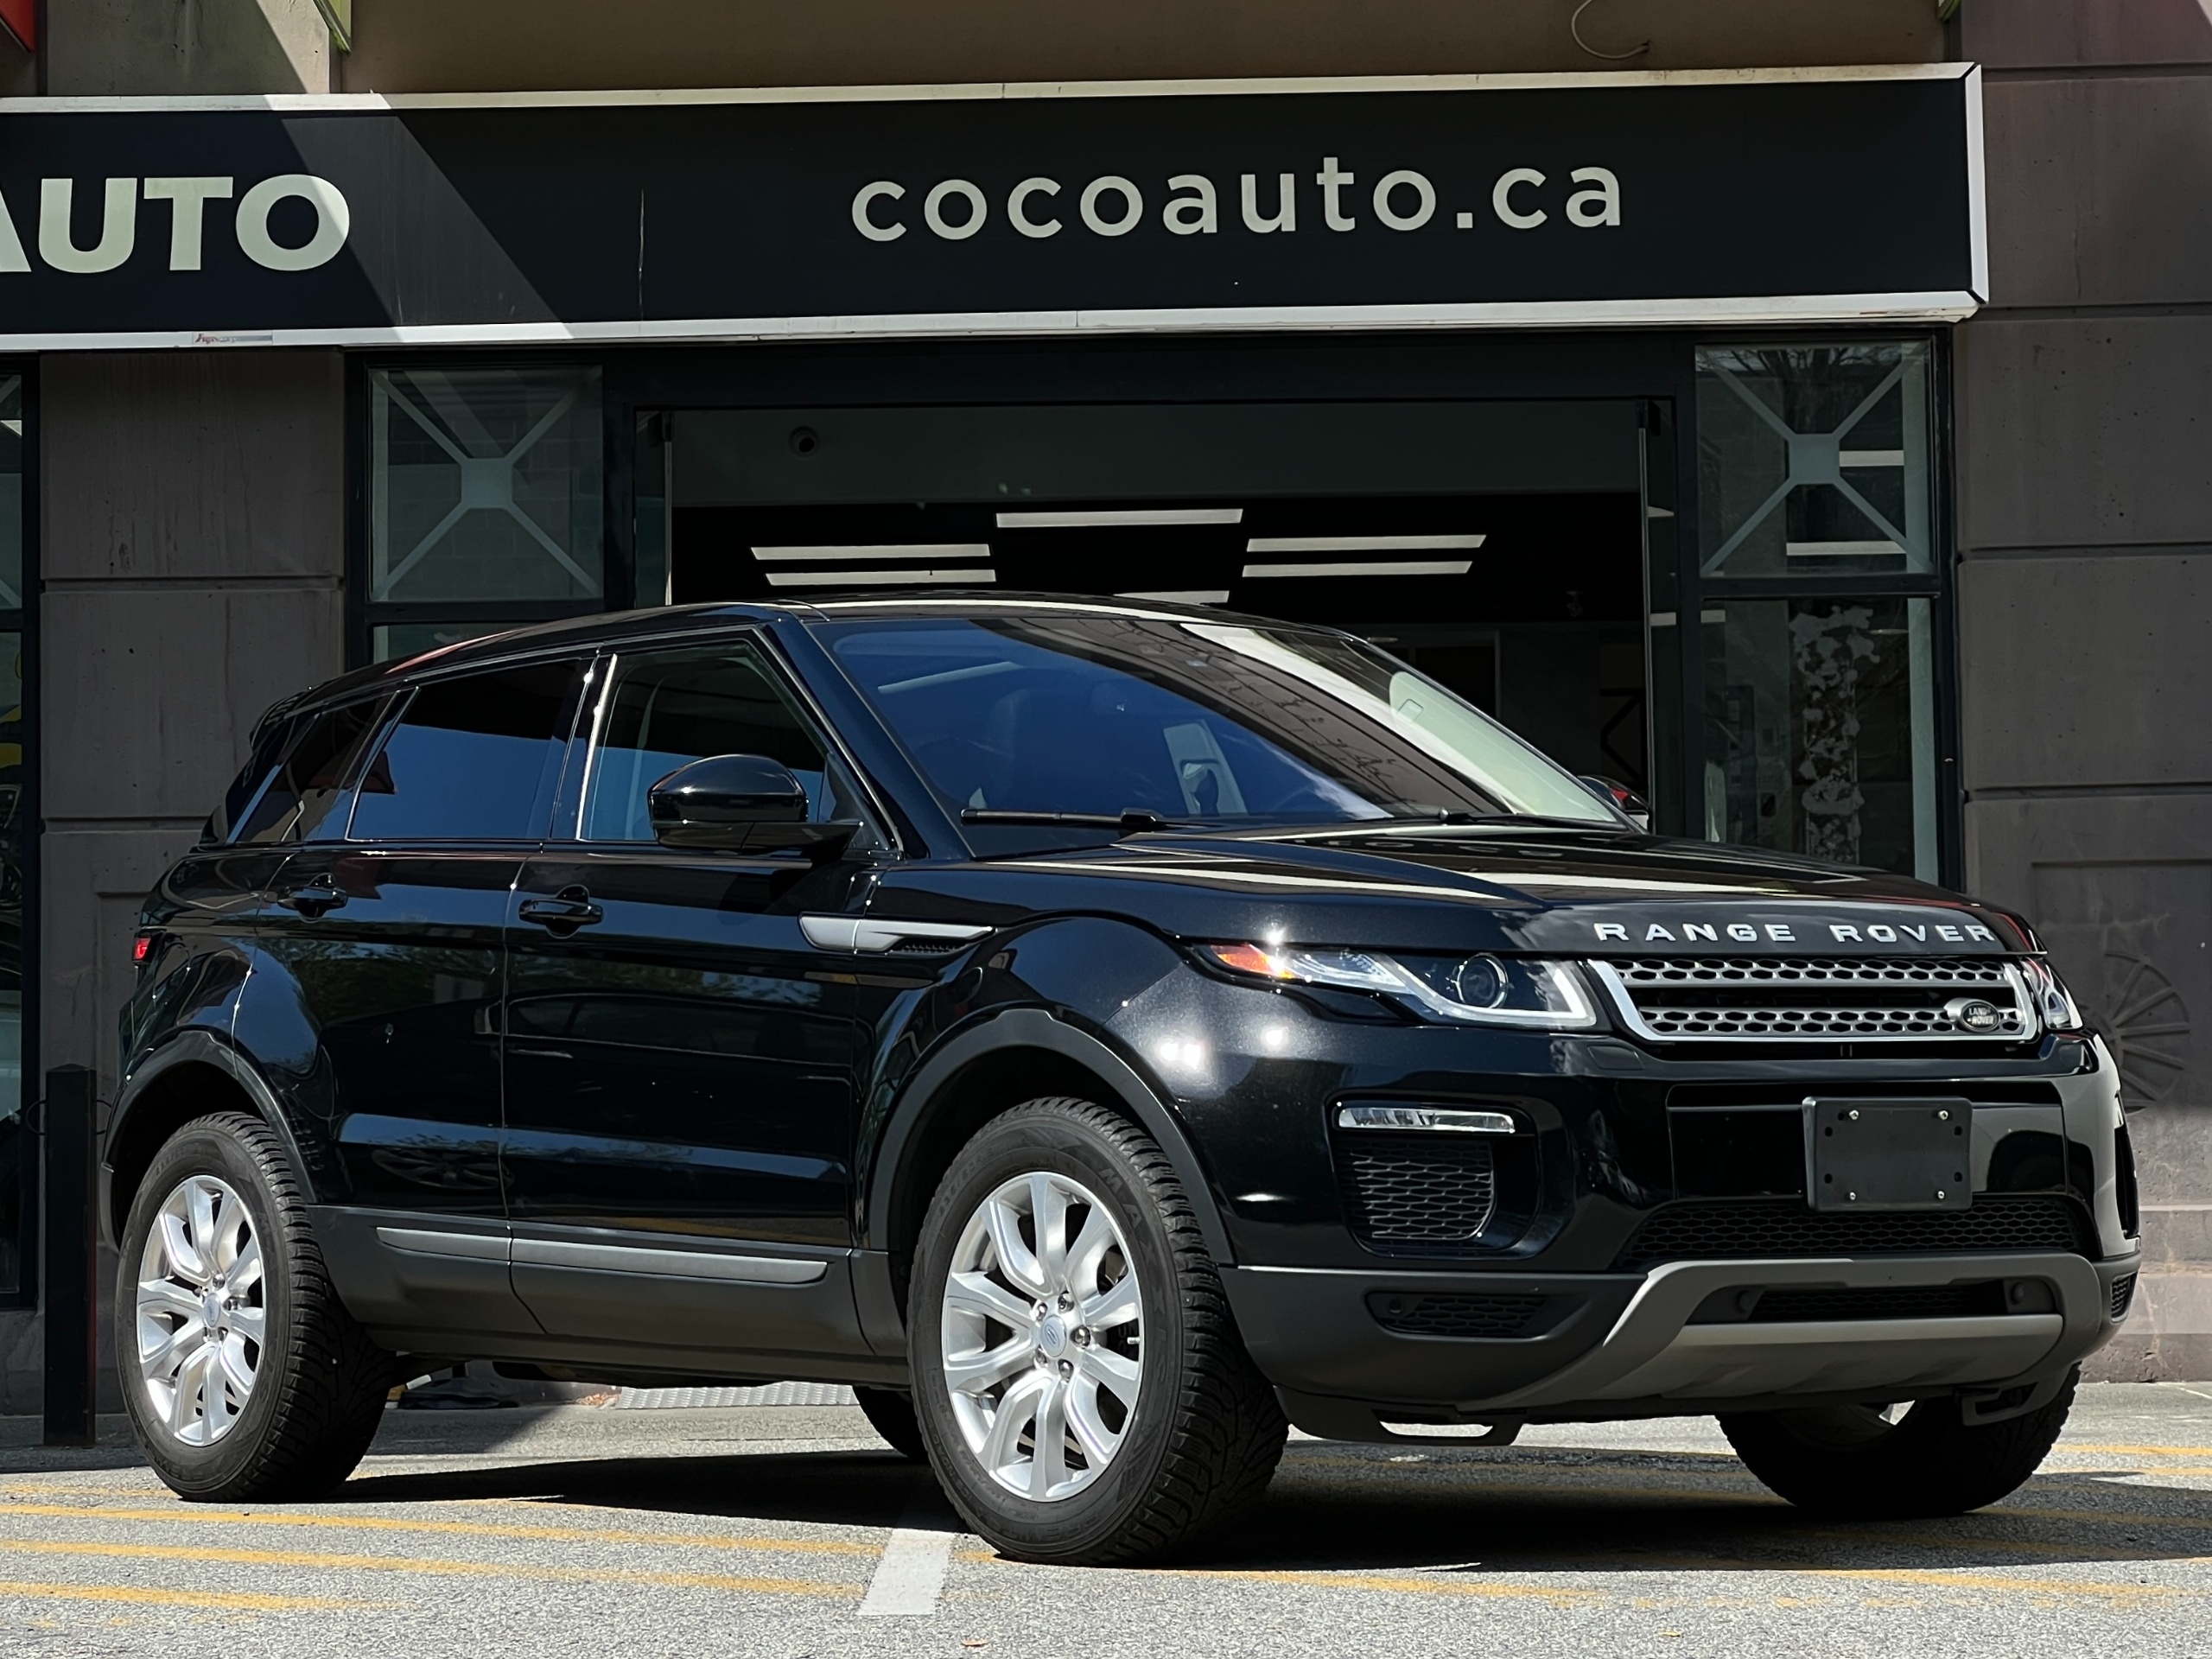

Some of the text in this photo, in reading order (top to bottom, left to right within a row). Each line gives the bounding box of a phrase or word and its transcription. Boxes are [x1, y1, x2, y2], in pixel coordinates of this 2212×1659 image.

[850, 157, 1623, 243] cocoauto.ca
[1593, 922, 1995, 944] RANGE ROVER
[1098, 1168, 1168, 1383] MAXXIS
